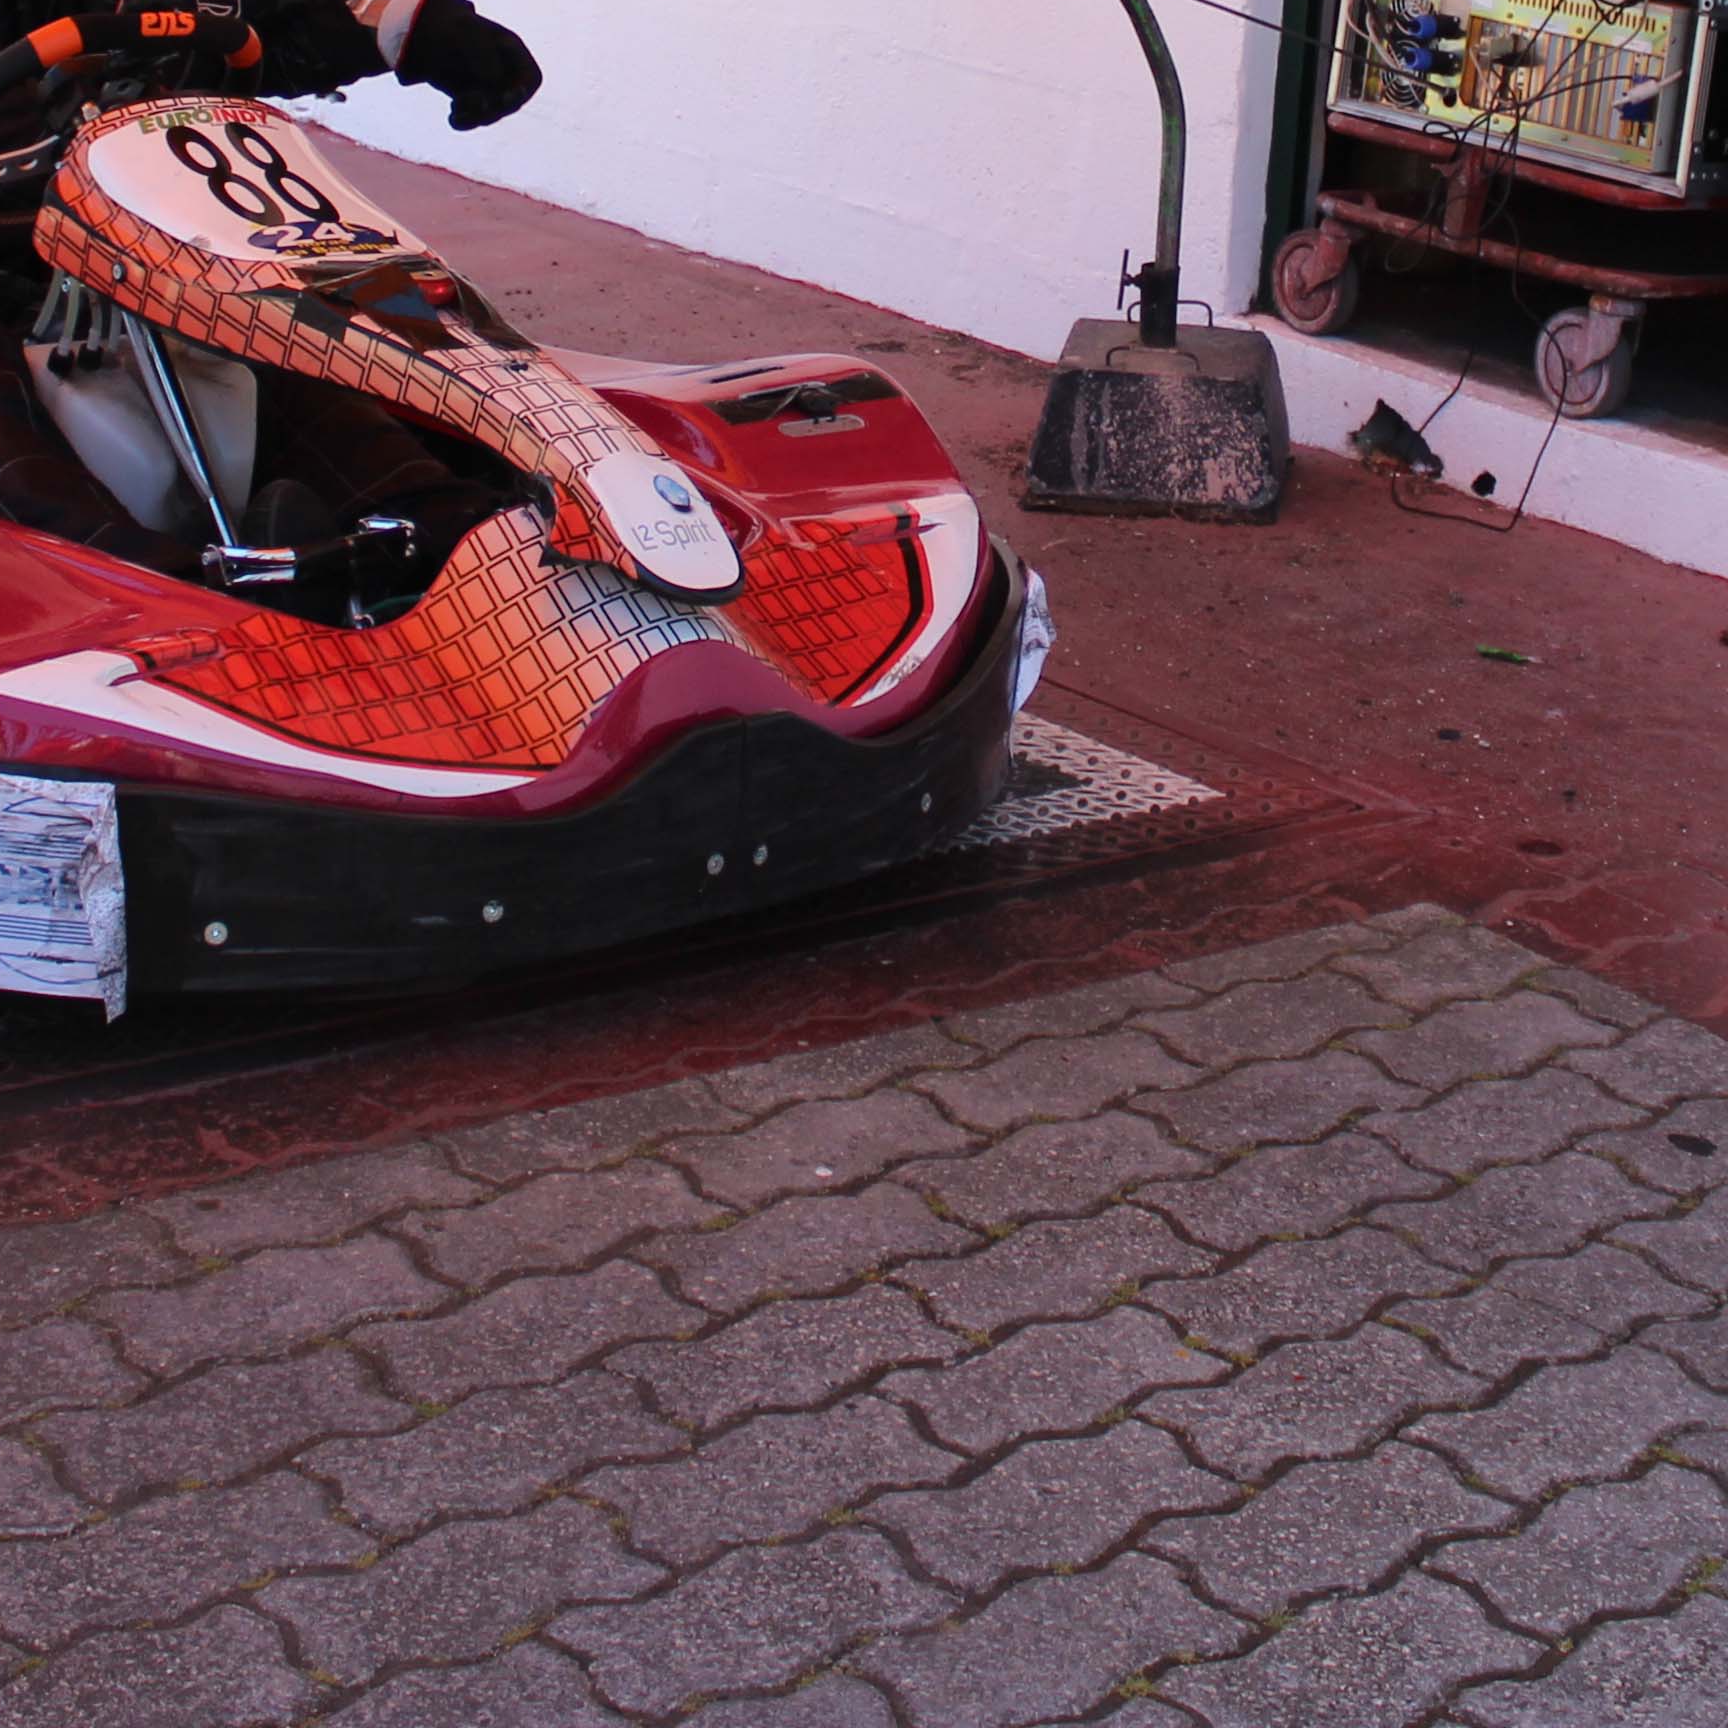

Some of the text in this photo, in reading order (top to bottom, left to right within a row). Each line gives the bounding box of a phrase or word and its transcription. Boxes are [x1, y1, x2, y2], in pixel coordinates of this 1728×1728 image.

[166, 124, 340, 226] 88
[262, 222, 356, 247] 24
[655, 519, 717, 551] Spirit
